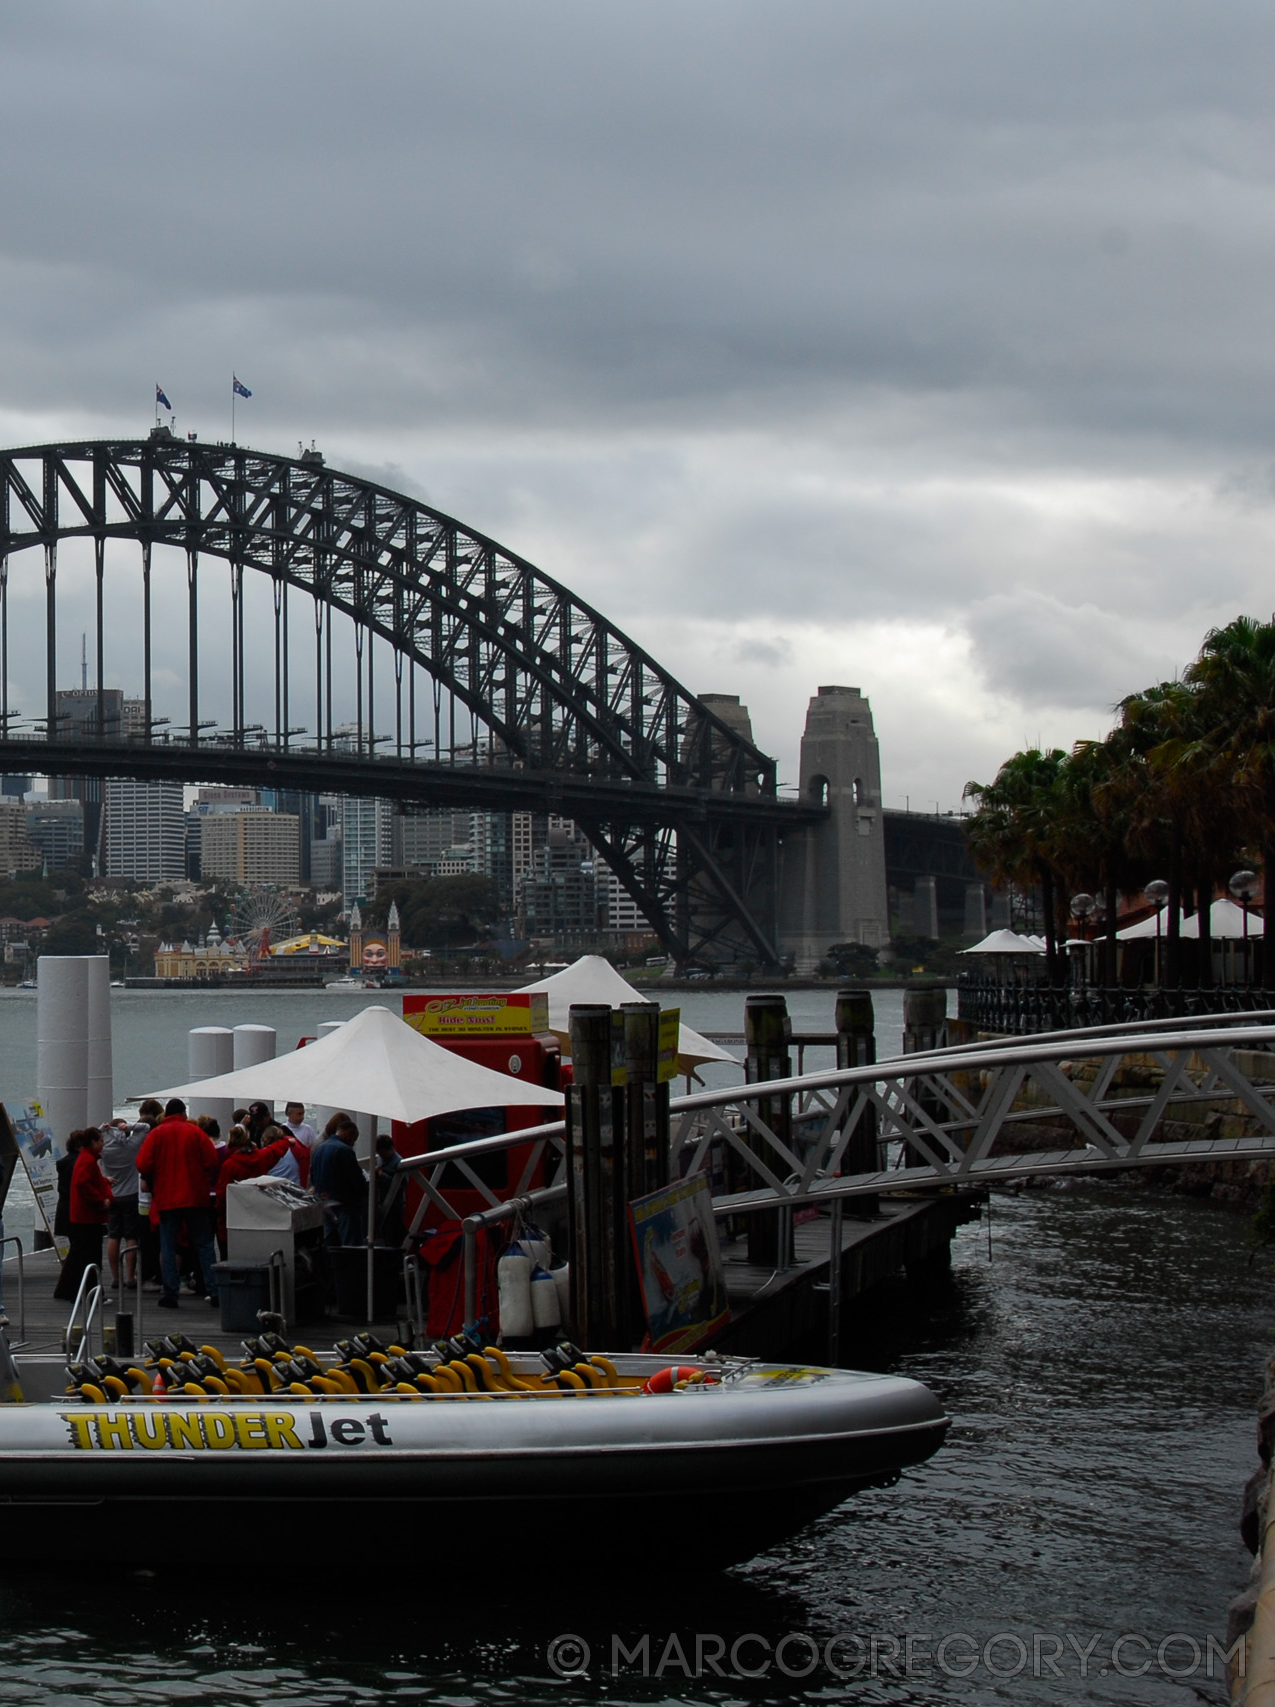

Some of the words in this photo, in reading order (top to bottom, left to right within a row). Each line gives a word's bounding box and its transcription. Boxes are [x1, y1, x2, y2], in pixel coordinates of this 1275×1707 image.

[467, 1015, 495, 1024] Now!
[60, 1411, 304, 1450] THUNDER
[308, 1412, 393, 1449] Jet
